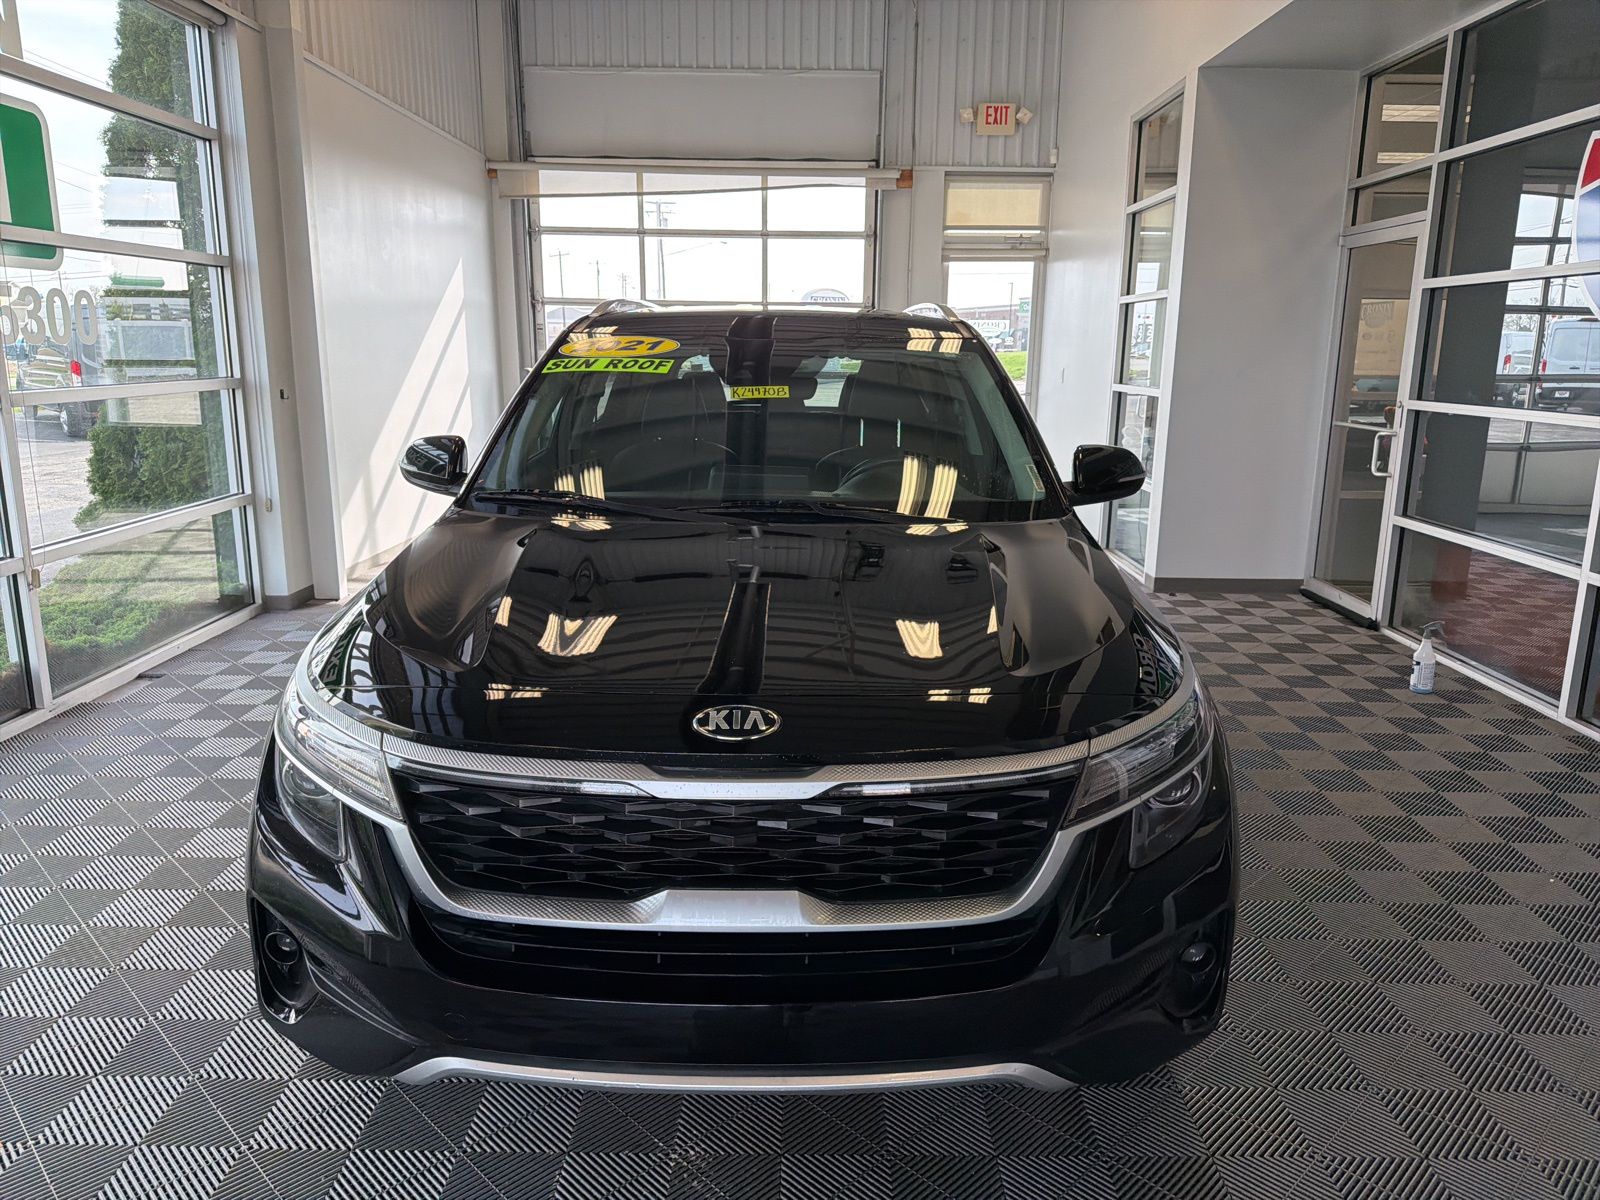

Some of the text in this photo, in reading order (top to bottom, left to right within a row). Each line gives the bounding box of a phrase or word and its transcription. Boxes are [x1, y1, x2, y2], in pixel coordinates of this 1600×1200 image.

[985, 105, 1010, 125] EXIT
[570, 340, 664, 354] 2021
[546, 358, 671, 371] SUN ROOF
[708, 709, 766, 731] KIA
